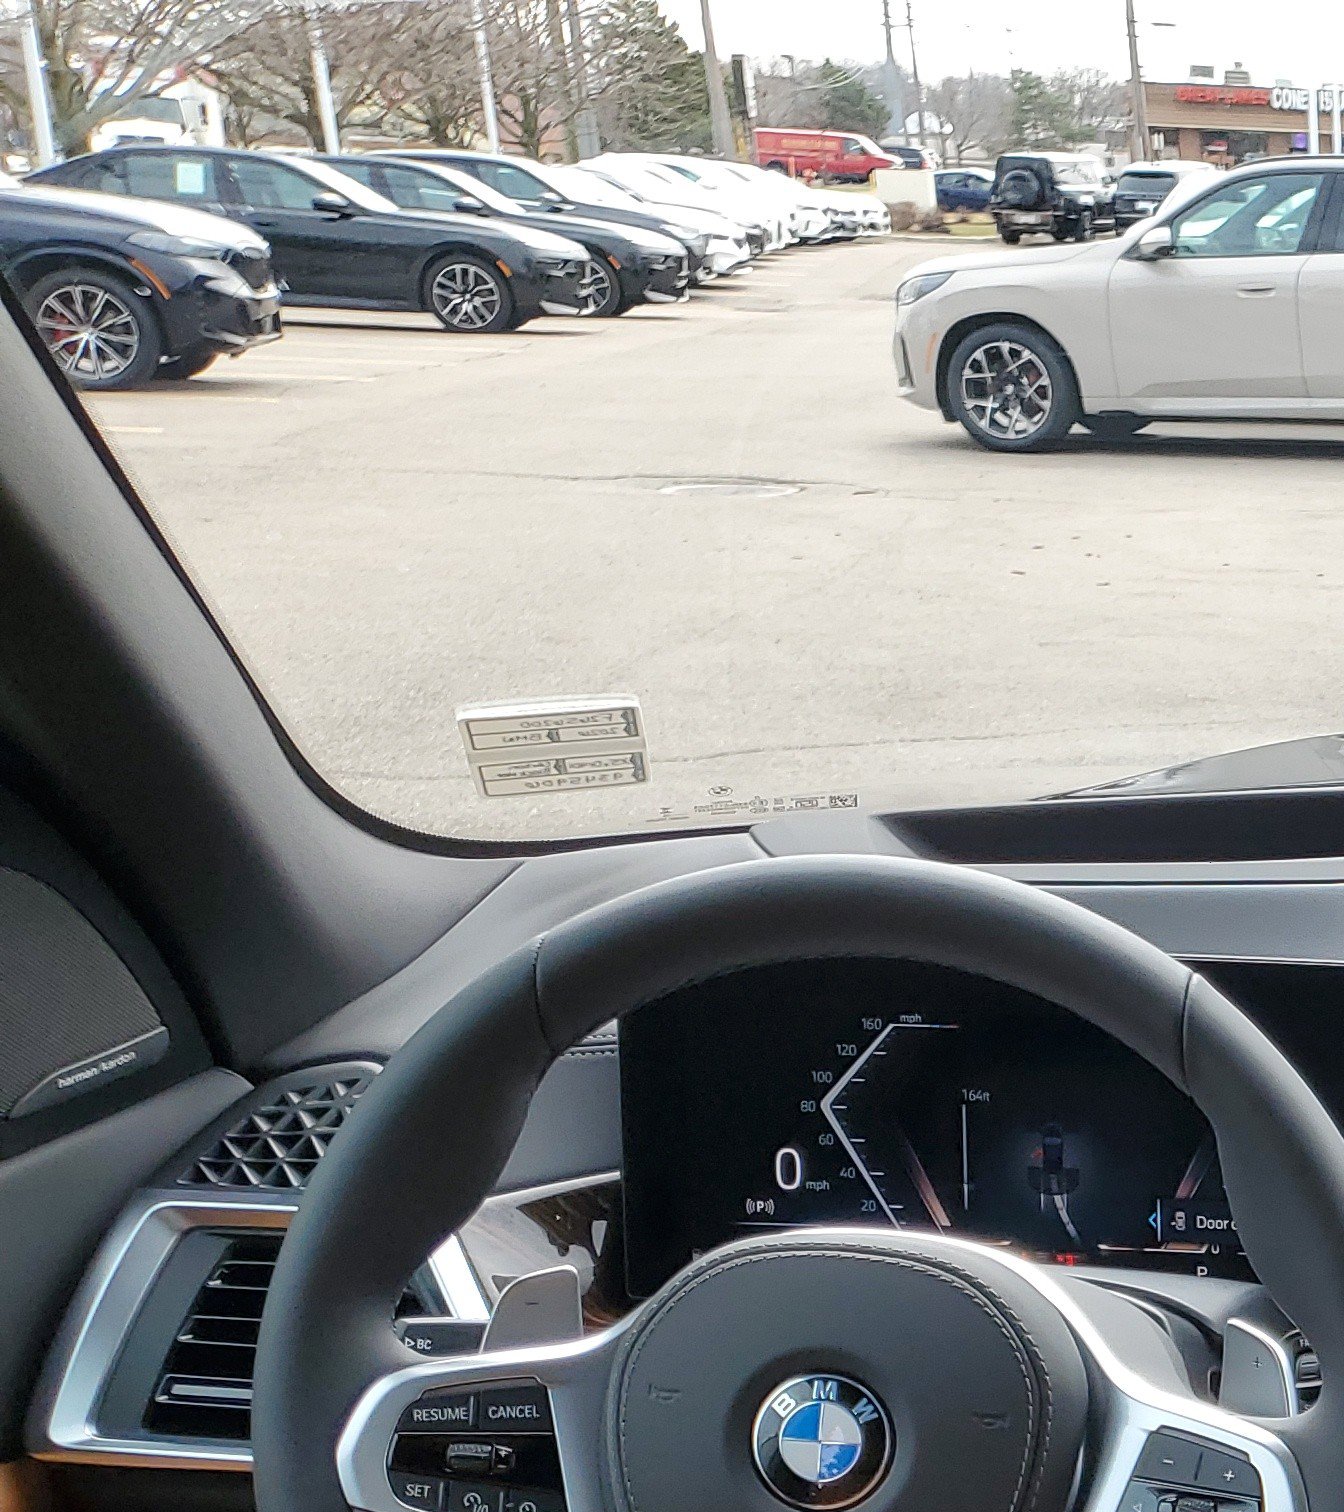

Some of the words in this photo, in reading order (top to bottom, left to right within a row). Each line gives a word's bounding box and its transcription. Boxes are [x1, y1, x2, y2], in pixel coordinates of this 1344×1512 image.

[1270, 87, 1310, 111] CONE
[861, 1018, 882, 1030] 160
[899, 1014, 922, 1024] mph
[836, 1044, 857, 1056] 120
[811, 1071, 833, 1083] 100
[800, 1101, 816, 1112] 80
[818, 1133, 834, 1146] 60
[775, 1148, 801, 1190] 0
[805, 1180, 830, 1191] mph
[839, 1168, 856, 1179] 40
[861, 1200, 877, 1212] 20
[1196, 1215, 1230, 1230] Door
[416, 1339, 432, 1350] BC
[771, 1379, 879, 1425] BMW
[413, 1407, 469, 1422] RESUME
[488, 1404, 541, 1419] CANCEL
[405, 1483, 431, 1498] SET
